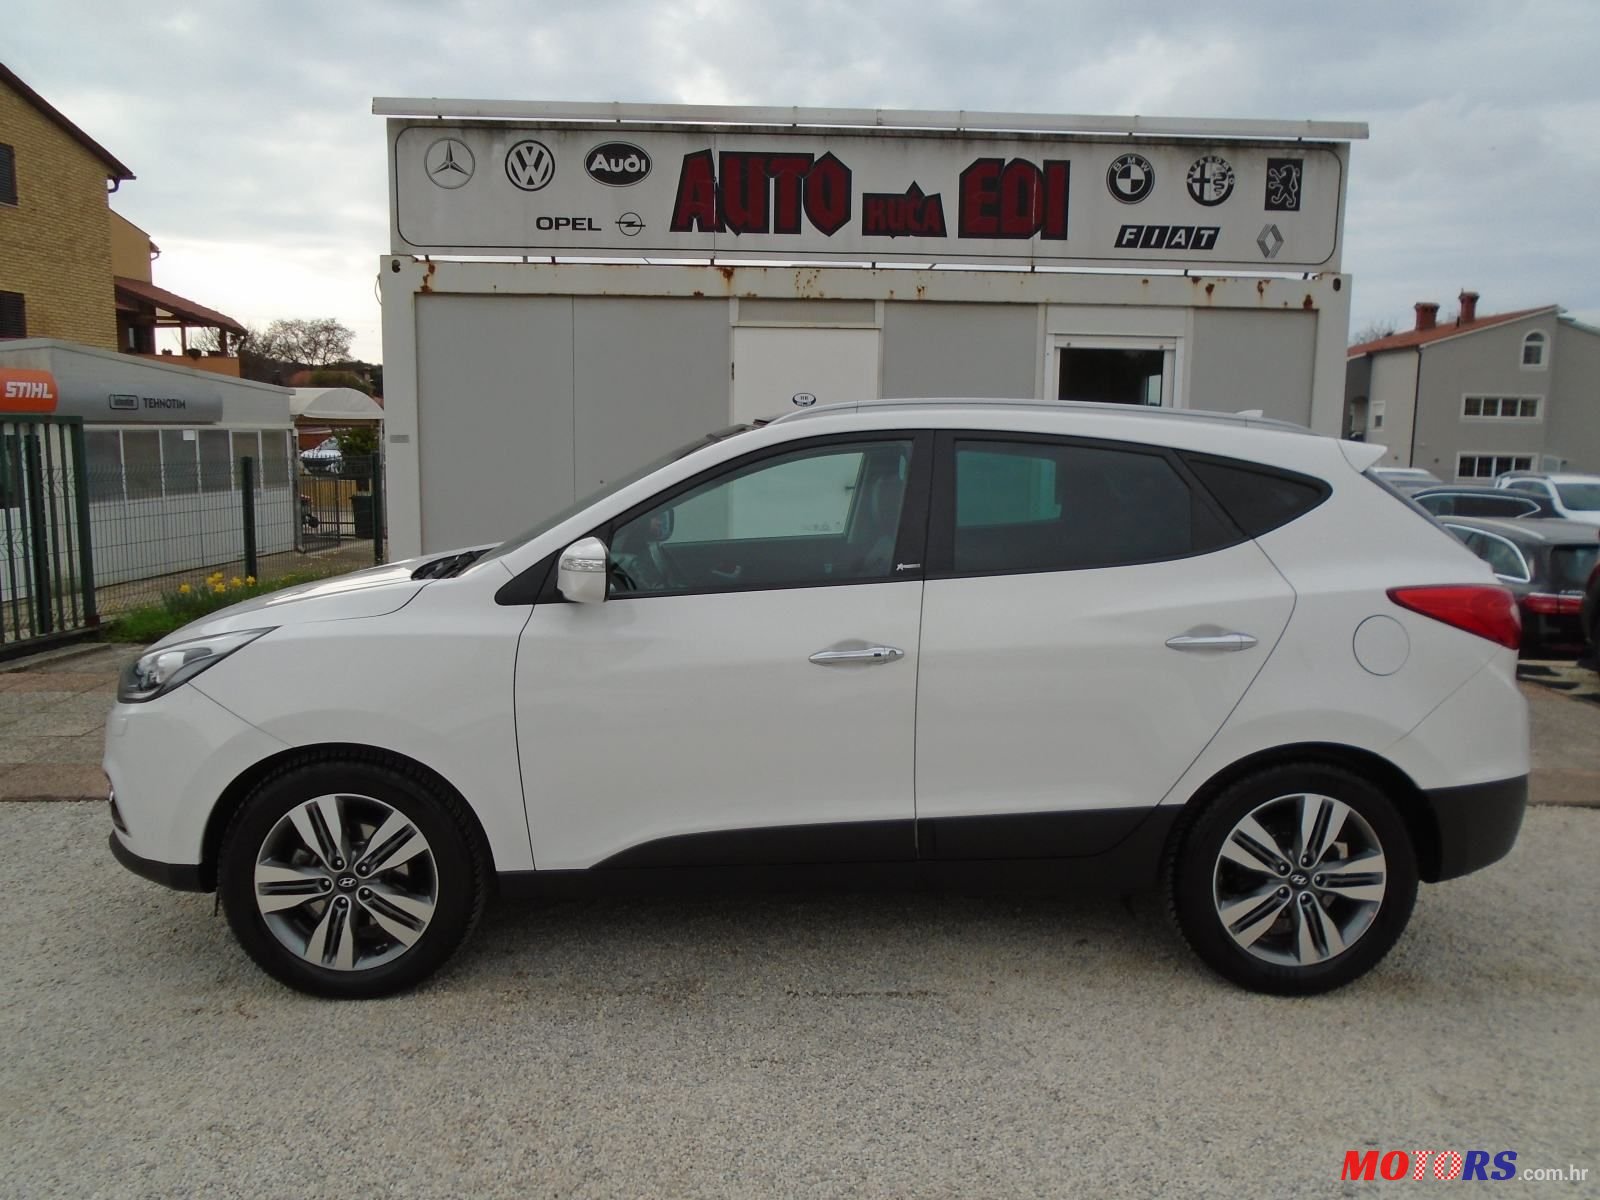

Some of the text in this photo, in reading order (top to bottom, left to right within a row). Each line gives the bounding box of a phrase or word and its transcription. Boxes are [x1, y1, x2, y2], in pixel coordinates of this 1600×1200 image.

[590, 154, 646, 172] Audi
[670, 149, 852, 237] AUTO
[958, 157, 1070, 240] EDI
[535, 216, 602, 231] OPEL
[1120, 227, 1216, 247] FIAT
[5, 381, 53, 398] STIHL
